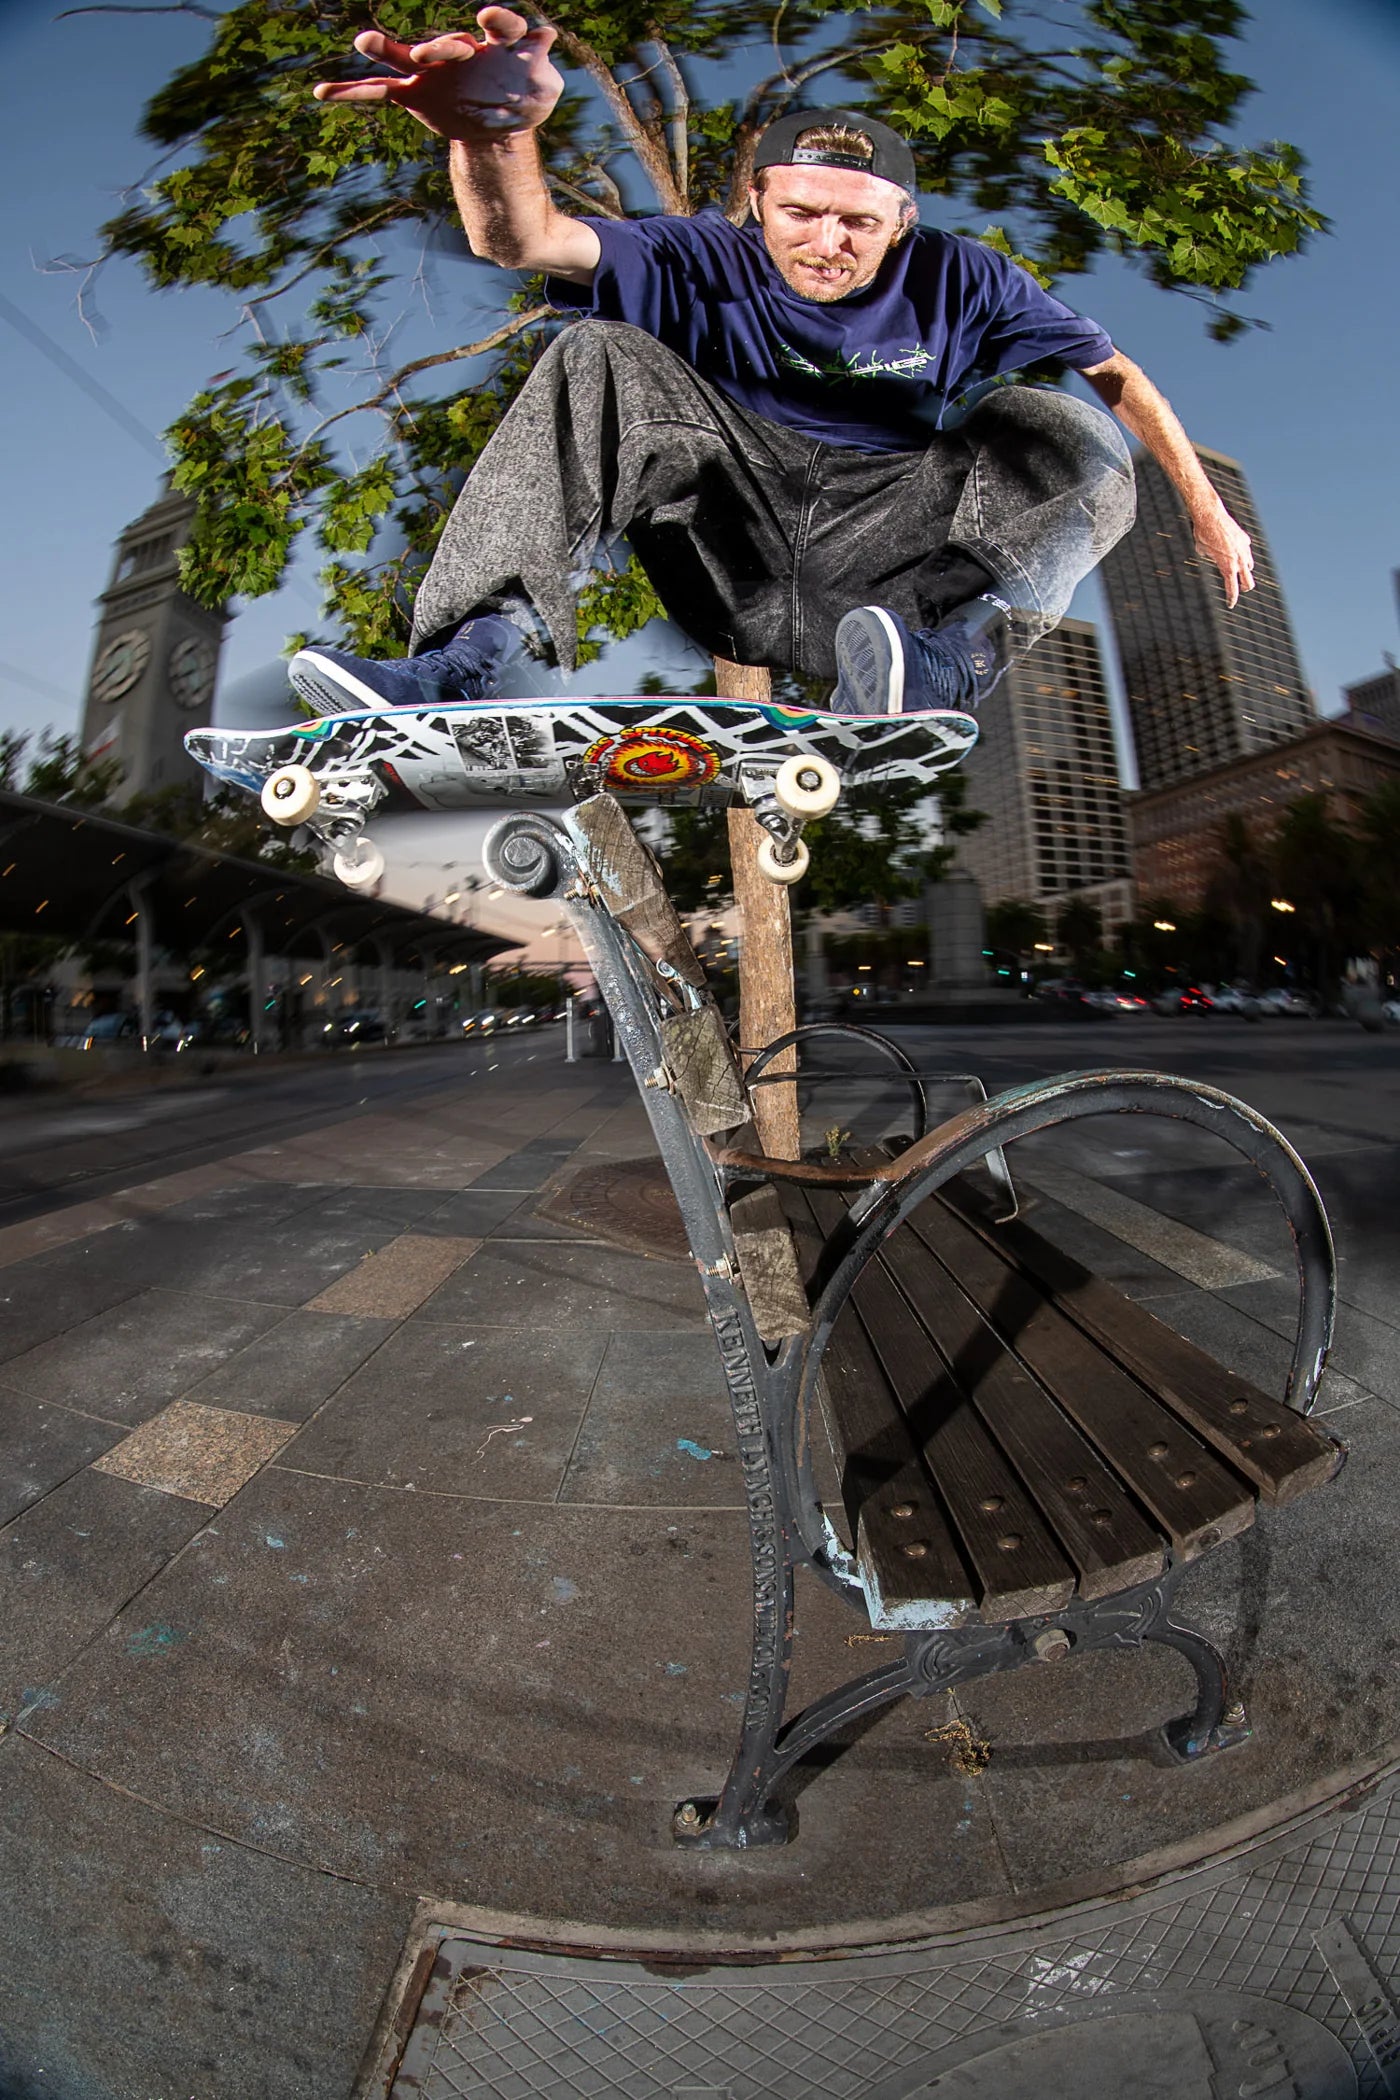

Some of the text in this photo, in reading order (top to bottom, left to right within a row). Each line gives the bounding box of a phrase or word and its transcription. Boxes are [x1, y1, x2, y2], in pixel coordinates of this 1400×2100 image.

[619, 726, 713, 752] SPITFIRE
[710, 1306, 763, 1438] KENNETH
[740, 1444, 774, 1521] LYNCH
